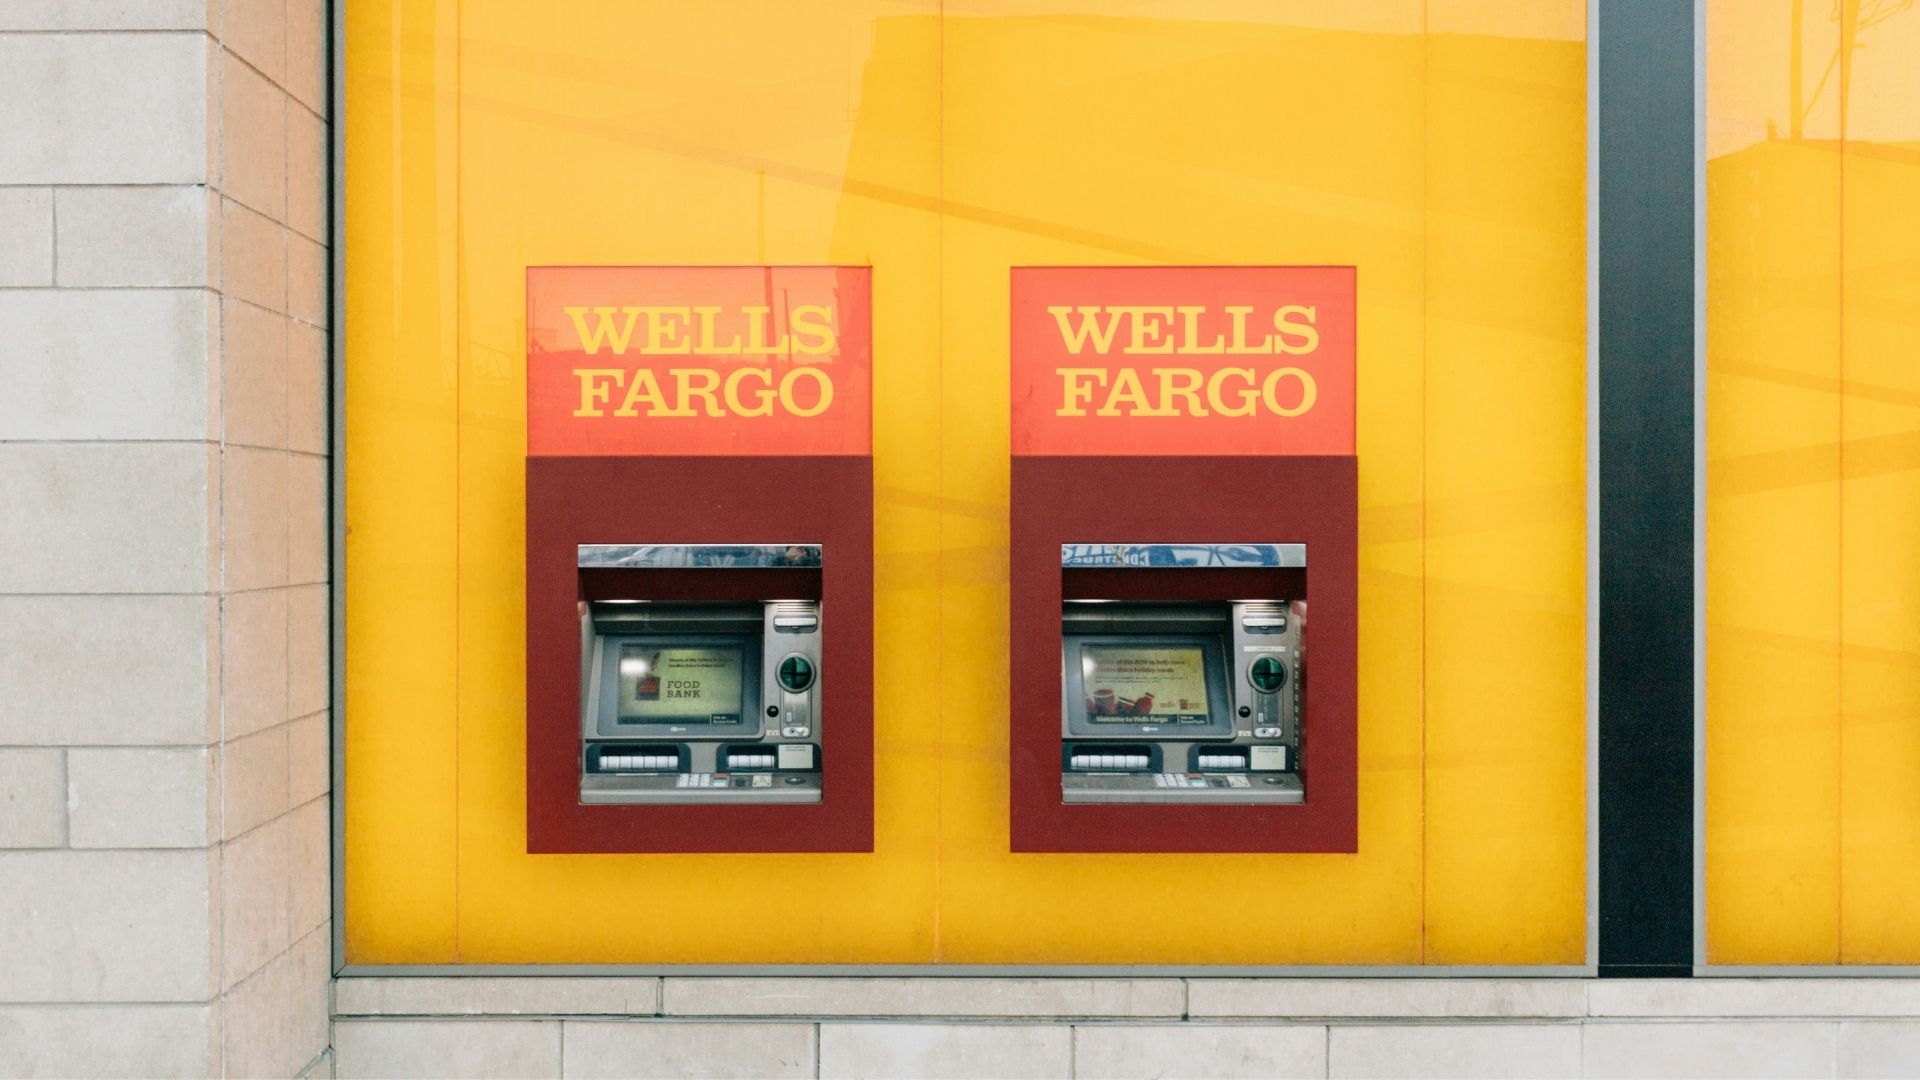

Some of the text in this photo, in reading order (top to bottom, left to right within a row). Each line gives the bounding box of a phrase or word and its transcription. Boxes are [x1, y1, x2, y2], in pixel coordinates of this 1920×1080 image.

[564, 305, 835, 355] WELLS
[1047, 305, 1320, 355] WELLS
[573, 367, 834, 417] FARGO
[1056, 367, 1318, 417] FARGO
[666, 690, 701, 698] BANK
[667, 680, 701, 689] FOOD
[1150, 716, 1169, 724] Fargo
